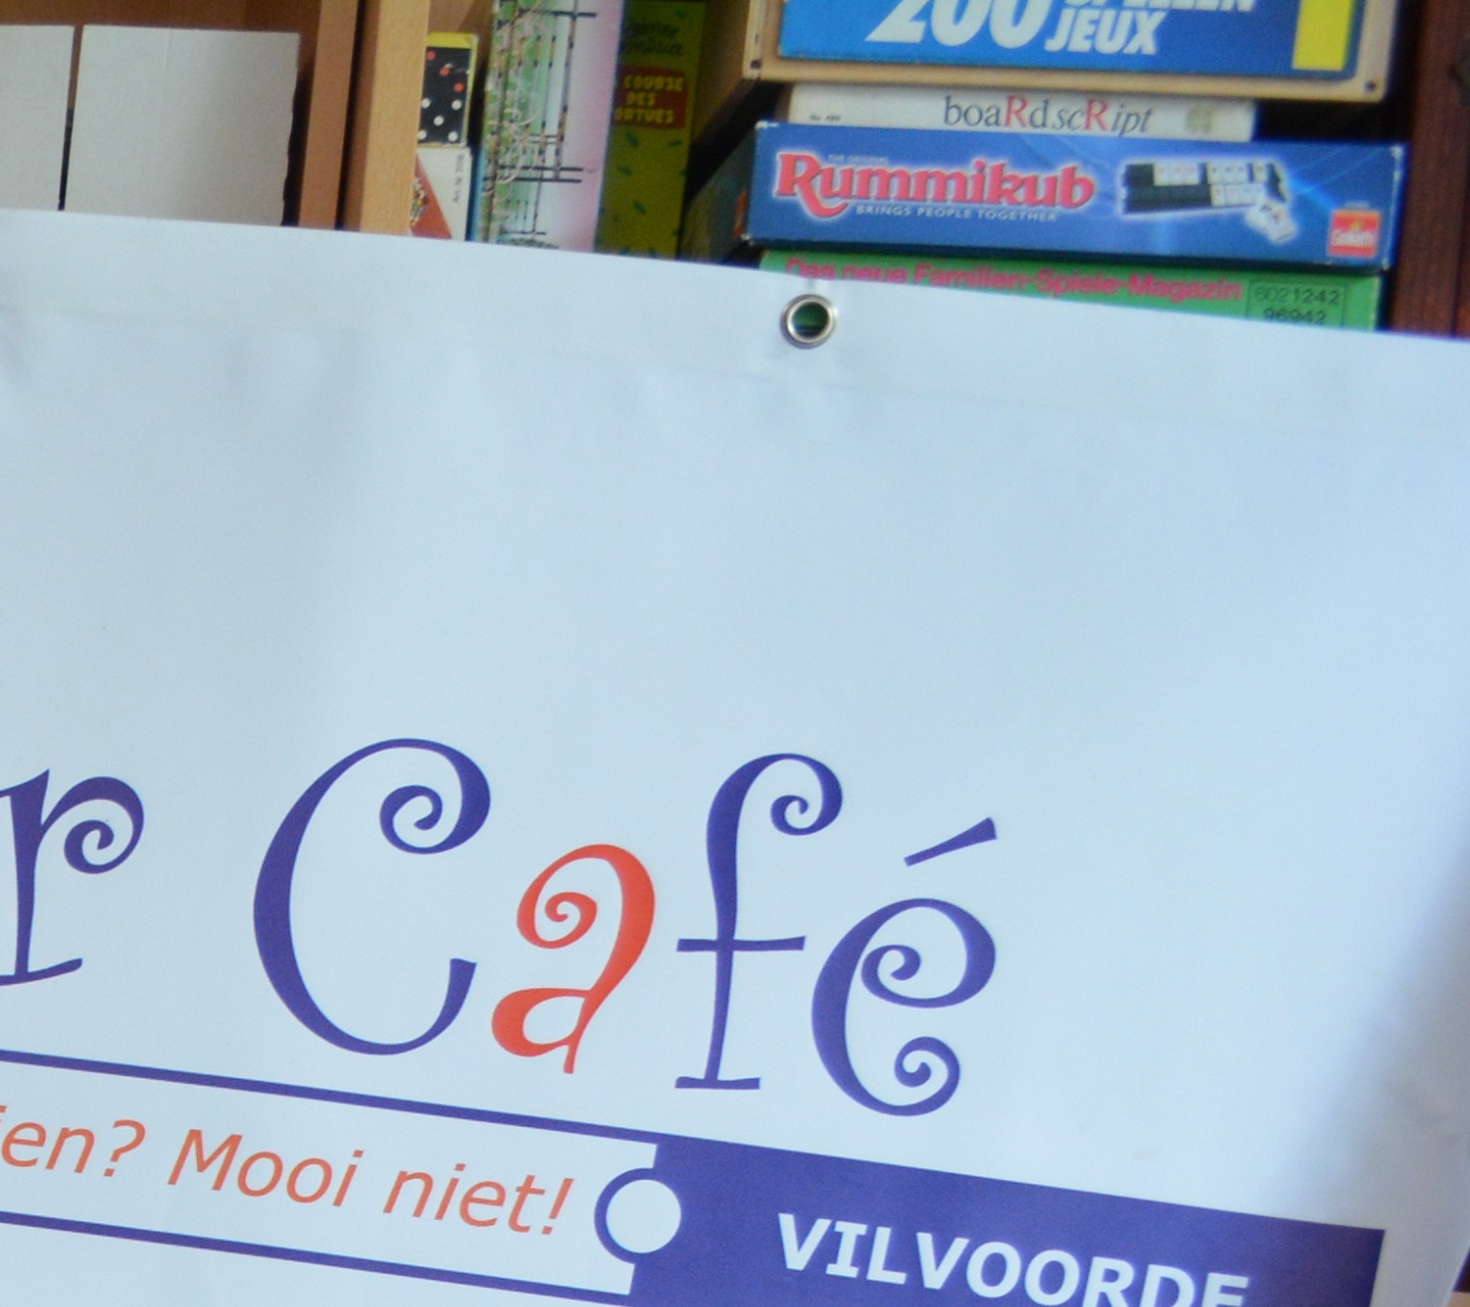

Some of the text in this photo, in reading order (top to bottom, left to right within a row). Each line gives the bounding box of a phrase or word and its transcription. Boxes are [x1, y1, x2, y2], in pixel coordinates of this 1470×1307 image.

[1044, 8, 1169, 56] JEUX
[623, 74, 685, 93] COURSE
[625, 91, 656, 107] DES
[614, 107, 675, 124] ORTUES
[774, 150, 1097, 219] Rummikub
[855, 204, 1057, 222] BRINGS PEOPLE TOGETHER
[840, 263, 908, 284] neue
[252, 737, 998, 1118] Café
[167, 1129, 365, 1209] Mooi
[381, 1162, 574, 1237] niet!
